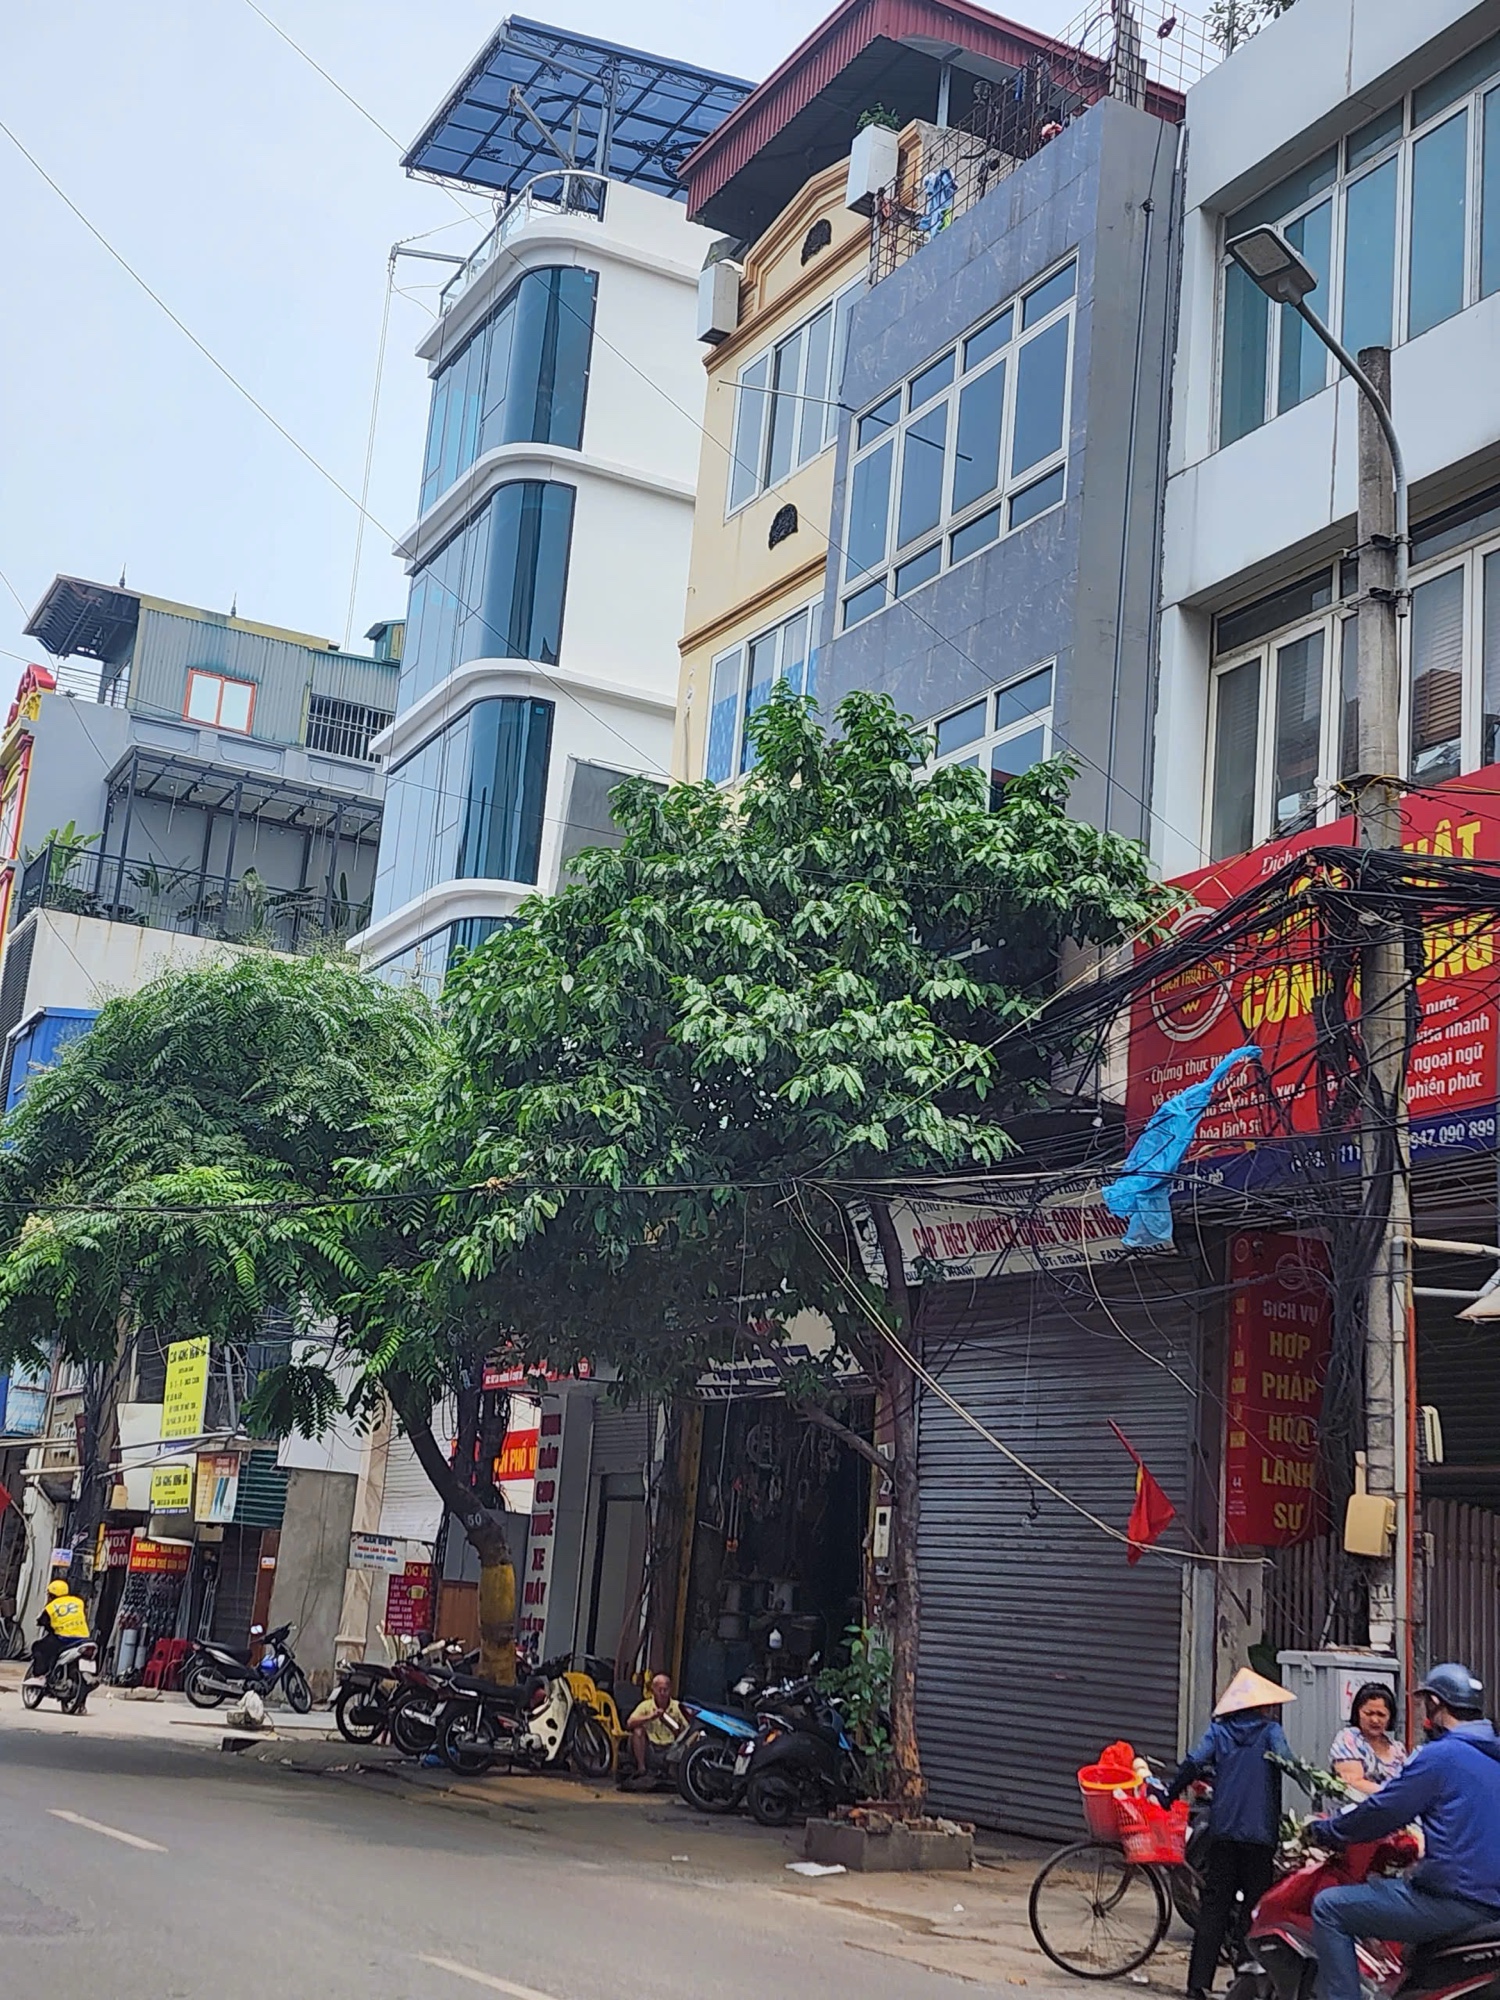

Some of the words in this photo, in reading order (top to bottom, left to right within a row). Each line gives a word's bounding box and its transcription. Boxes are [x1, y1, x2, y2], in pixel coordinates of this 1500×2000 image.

[1414, 1047, 1453, 1074] ngoại
[1455, 1042, 1485, 1066] ngữ
[1448, 1070, 1483, 1095] phức
[1262, 1299, 1296, 1321] DỊCH
[1300, 1303, 1319, 1328] VỤ
[1269, 1330, 1311, 1364] HỢP
[1261, 1370, 1318, 1403] PHÁP
[1268, 1411, 1311, 1446] HÓA
[1261, 1454, 1316, 1489] LÃNH
[1273, 1501, 1305, 1536] SỰ
[532, 1547, 545, 1571] XE
